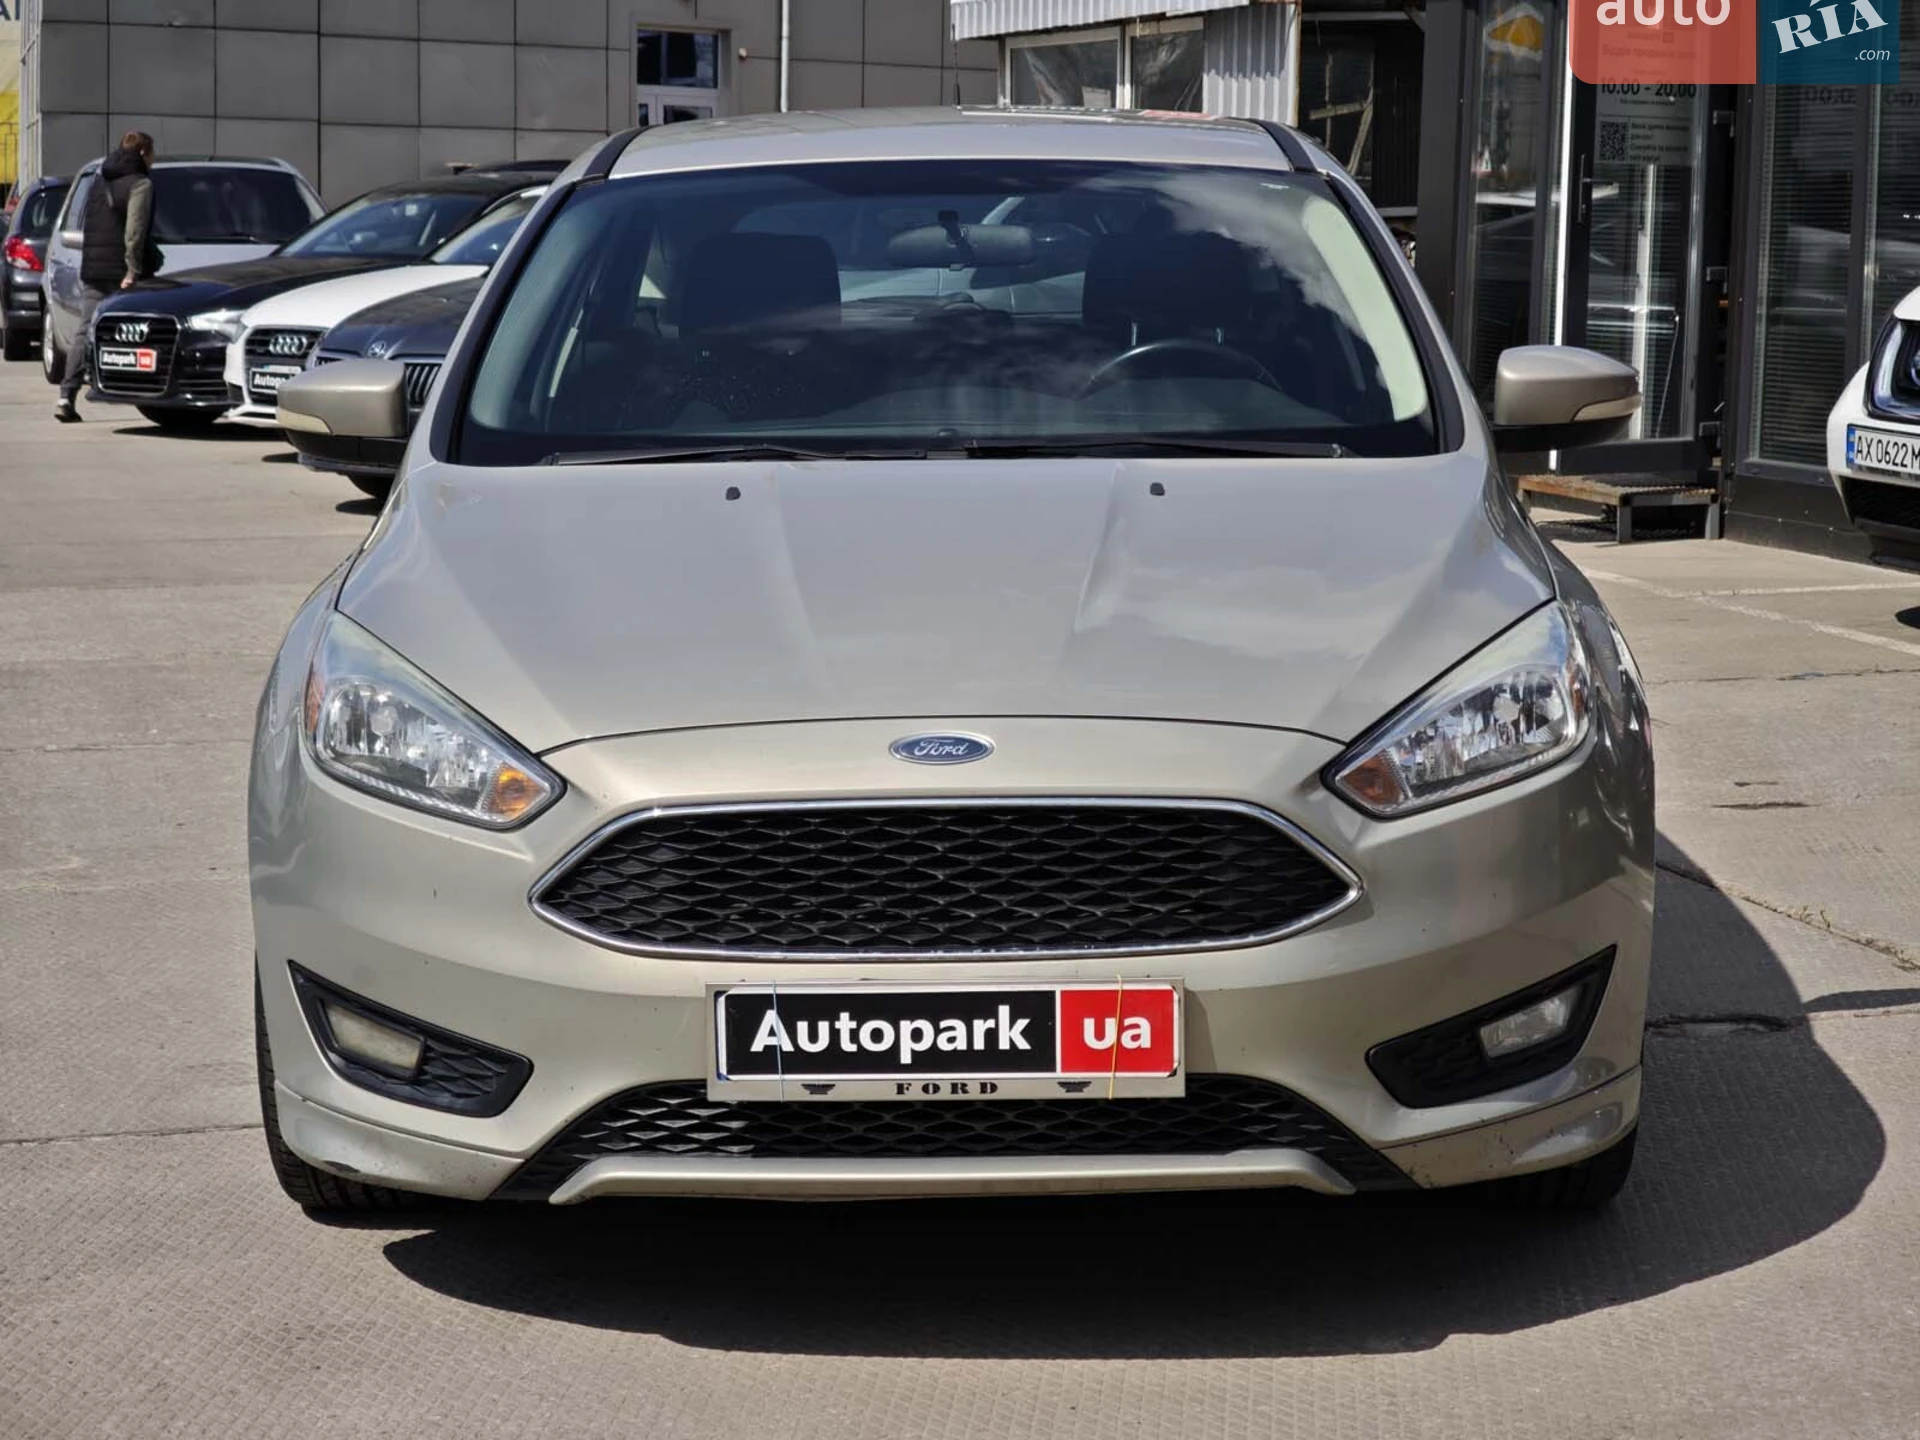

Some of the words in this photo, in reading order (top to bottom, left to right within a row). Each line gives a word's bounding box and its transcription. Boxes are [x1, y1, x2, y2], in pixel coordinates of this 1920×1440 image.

[1601, 78, 1641, 96] 10.00
[103, 352, 136, 366] Autopark
[1856, 436, 1874, 462] AX
[1876, 438, 1909, 468] 0622
[914, 739, 969, 756] Ford
[750, 1005, 1032, 1064] Autopark
[1083, 1015, 1152, 1051] ua
[895, 1081, 999, 1096] FORD
